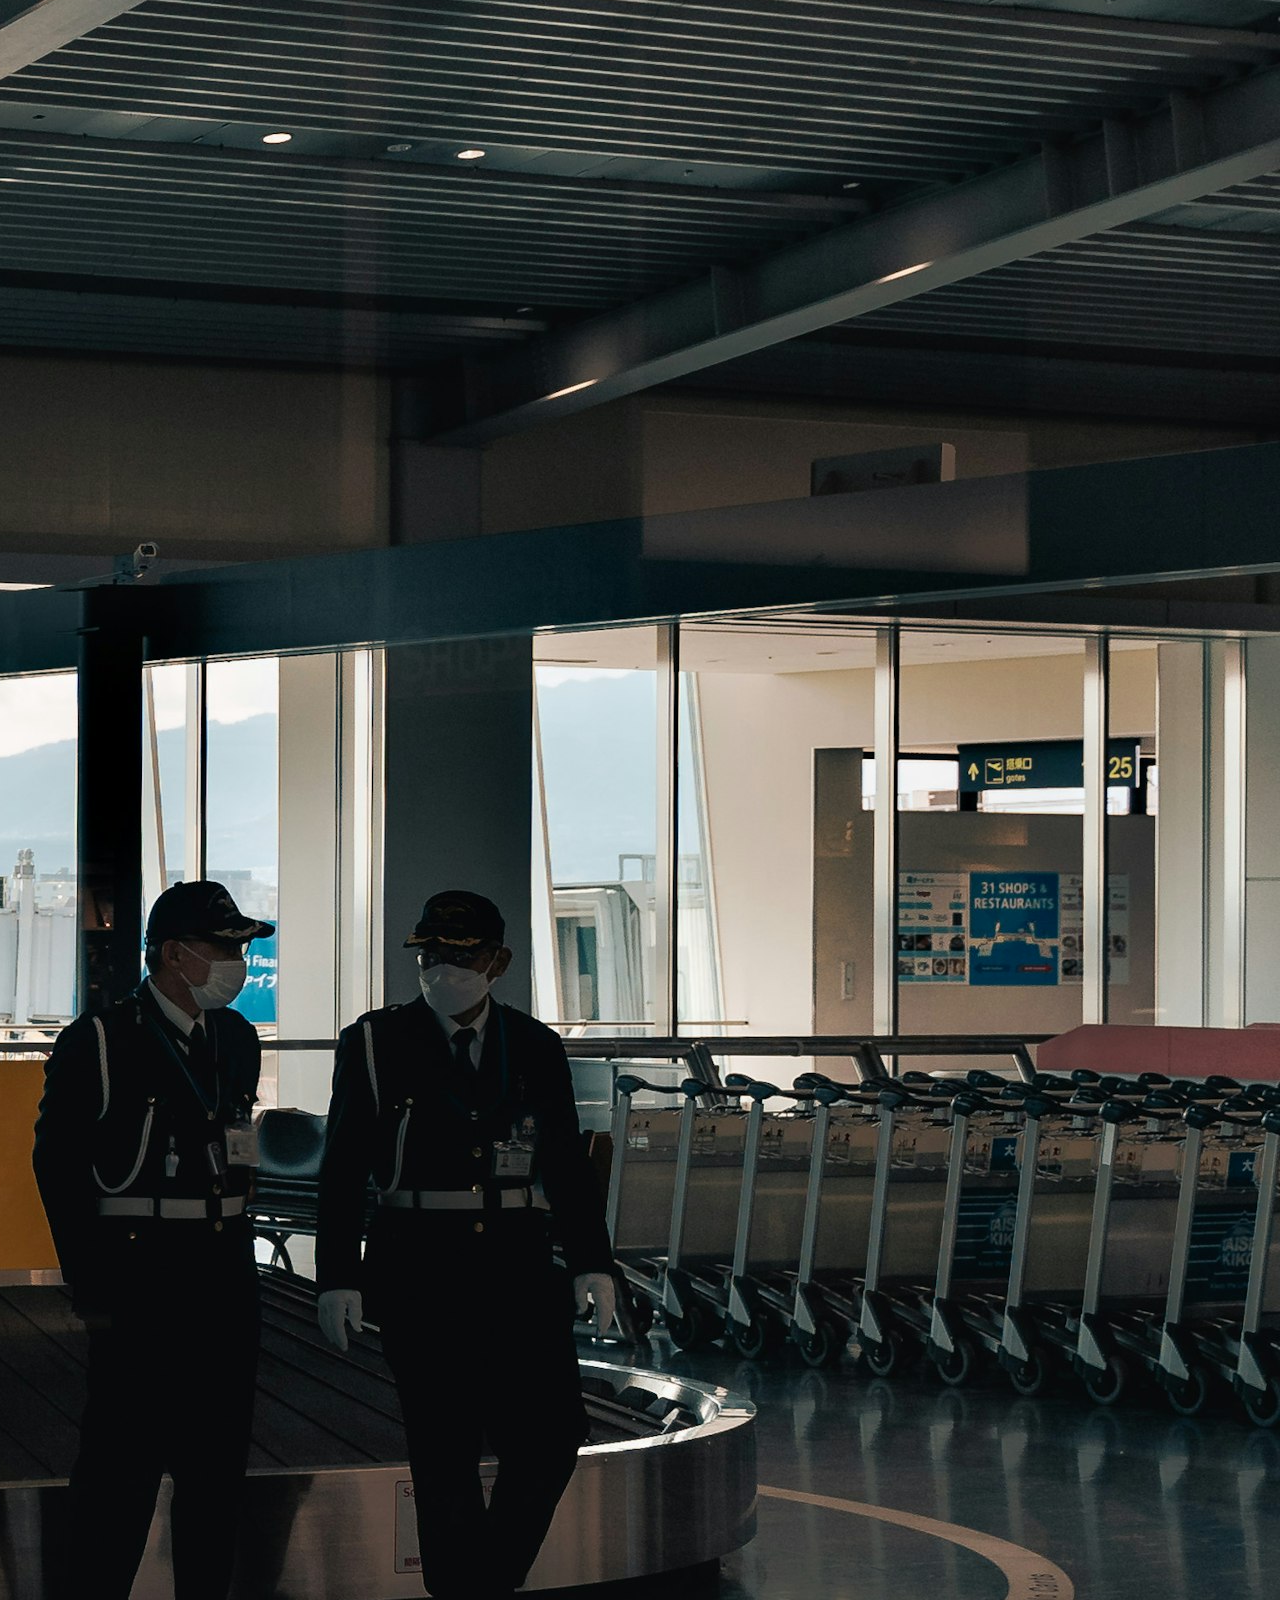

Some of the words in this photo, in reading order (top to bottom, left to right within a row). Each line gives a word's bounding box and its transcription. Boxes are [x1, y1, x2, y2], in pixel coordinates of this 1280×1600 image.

[981, 881, 995, 894] 31
[998, 882, 1037, 894] SHOPS
[973, 896, 1055, 909] RESTAURANTS
